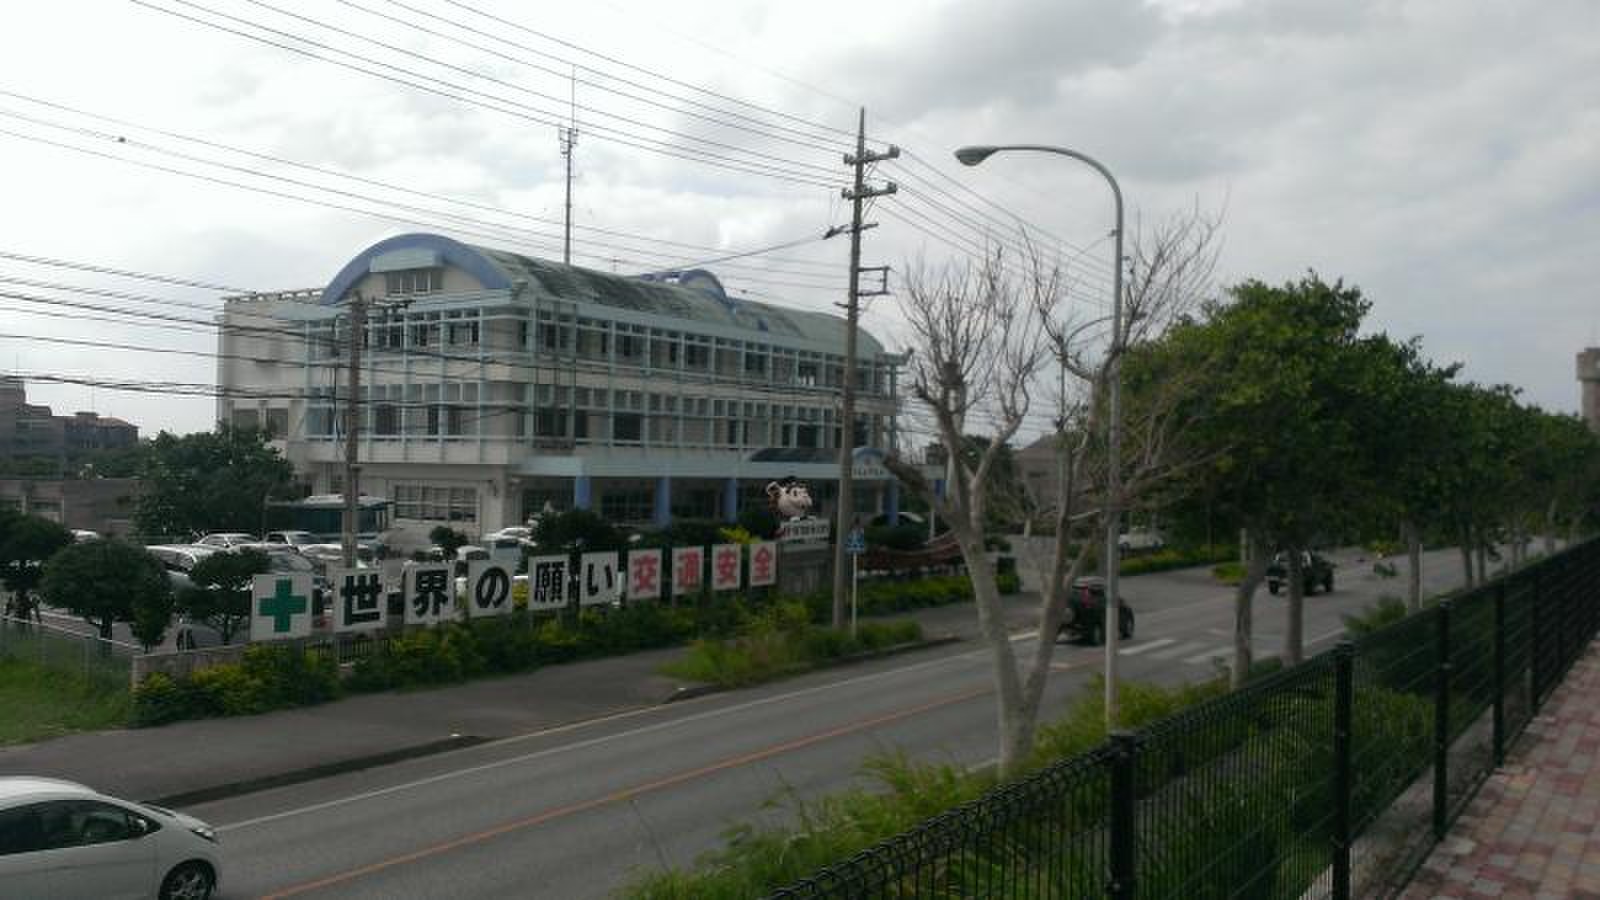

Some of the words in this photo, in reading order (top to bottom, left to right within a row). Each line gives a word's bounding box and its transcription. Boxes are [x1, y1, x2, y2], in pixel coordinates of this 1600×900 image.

[340, 546, 771, 626] 世界の願い交通安全
